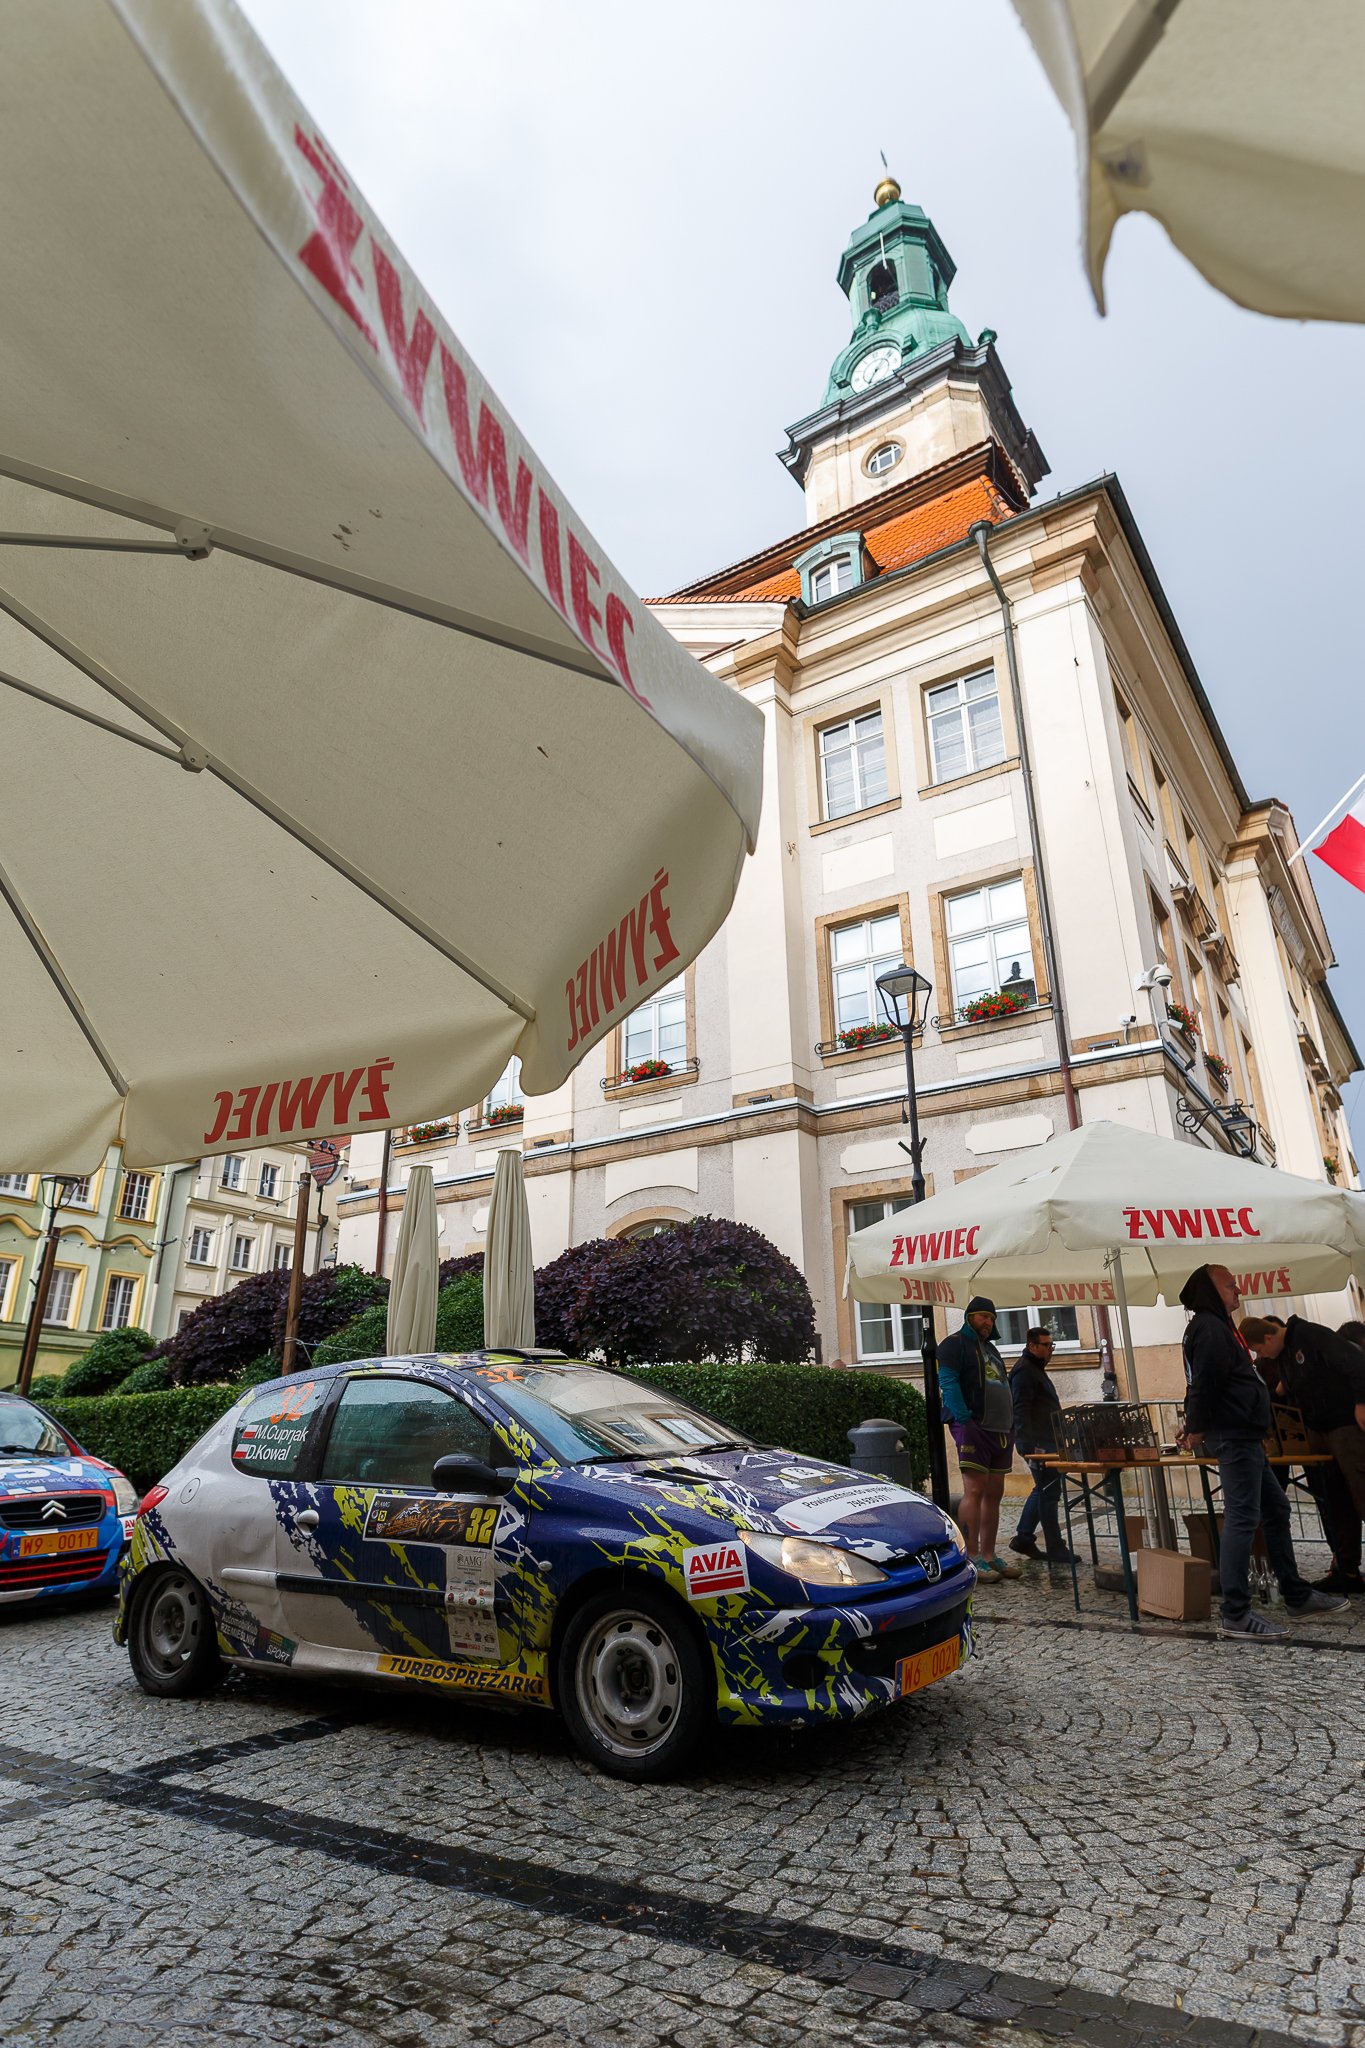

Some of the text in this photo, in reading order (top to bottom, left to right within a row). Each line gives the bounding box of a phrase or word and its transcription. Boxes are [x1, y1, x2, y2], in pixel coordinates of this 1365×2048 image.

[1122, 1207, 1260, 1238] ŻYWIEC
[889, 1225, 980, 1267] ŻYWIEC
[476, 1368, 525, 1382] 32
[269, 1382, 315, 1425] 32
[246, 1444, 291, 1460] D.Kowal
[465, 1507, 497, 1544] 32
[24, 1532, 95, 1555] W9 001Y
[464, 1556, 482, 1566] AMG
[266, 1644, 290, 1662] SPORT
[905, 1642, 958, 1691] W6 002V
[389, 1657, 544, 1694] TURBOSPRĘŻARKI
